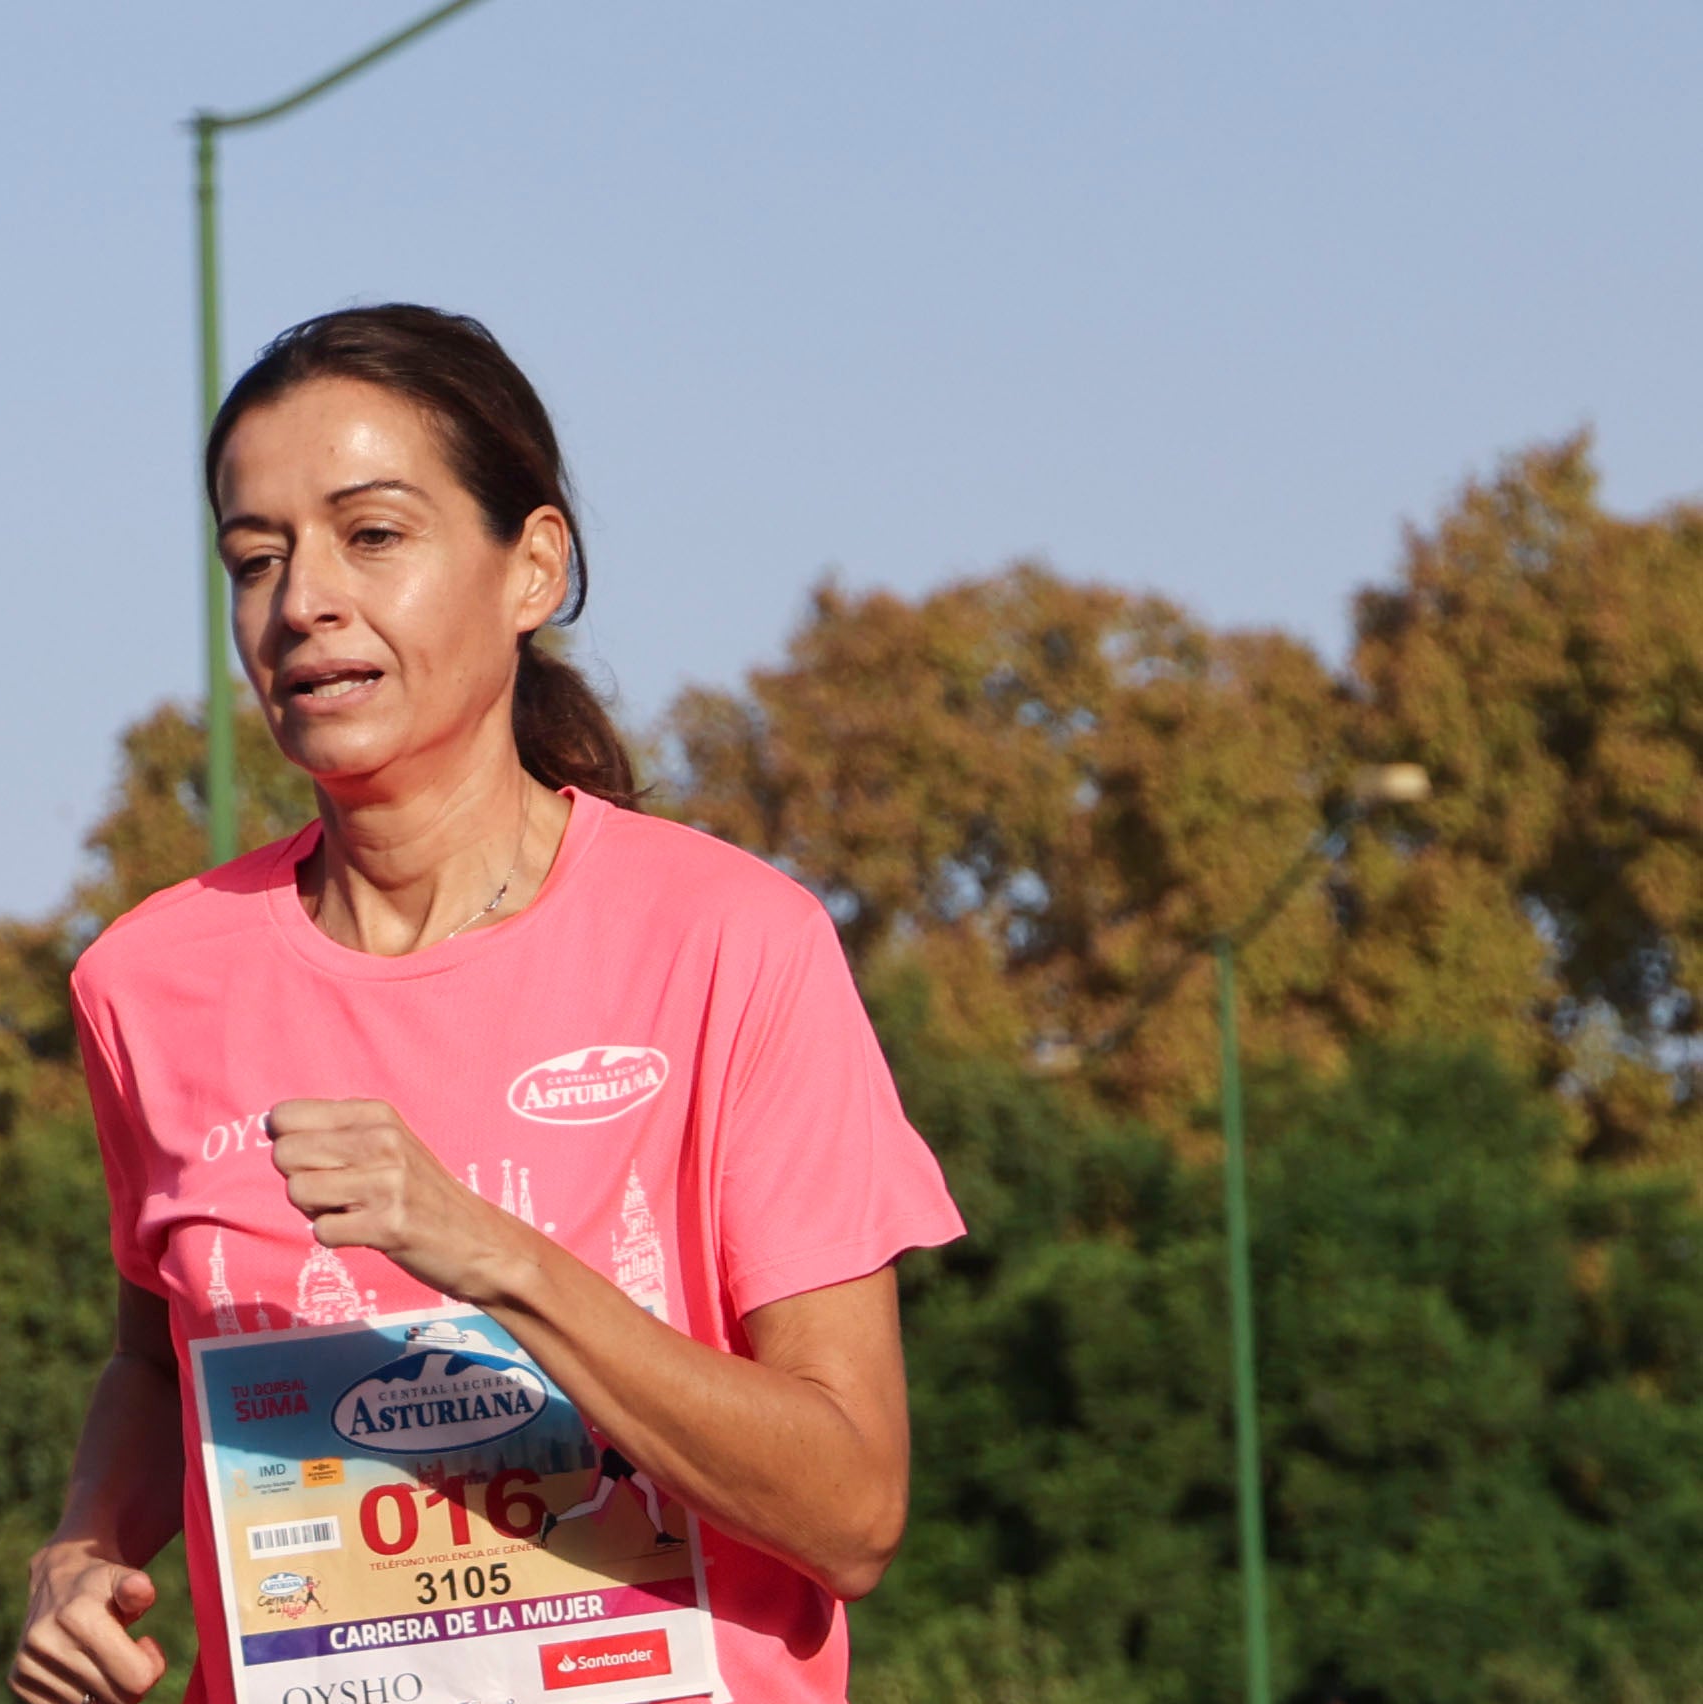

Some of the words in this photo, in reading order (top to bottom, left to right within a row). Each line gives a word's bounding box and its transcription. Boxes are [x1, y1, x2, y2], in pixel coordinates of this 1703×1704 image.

[522, 1065, 659, 1110] ASTURIANA
[546, 1073, 602, 1086] CENTRAL
[202, 1111, 274, 1162] OYS
[231, 1385, 249, 1399] TU
[254, 1378, 309, 1396] DORSAL
[378, 1384, 444, 1401] CENTRAL
[453, 1374, 523, 1392] LECHERA
[235, 1394, 310, 1423] SUMA
[348, 1388, 535, 1436] ASTURIANA
[259, 1463, 287, 1478] IMD
[359, 1468, 547, 1556] 016
[369, 1556, 426, 1572] TELÉFONO
[426, 1550, 486, 1564] VIOLENCIA
[487, 1547, 502, 1557] DE
[503, 1541, 548, 1555] GÉNERO
[415, 1562, 512, 1605] 3105
[329, 1616, 440, 1650] CARRERA
[445, 1611, 477, 1636] DE
[484, 1606, 515, 1630] LA
[521, 1594, 604, 1626] MUJER
[578, 1649, 654, 1670] Santander
